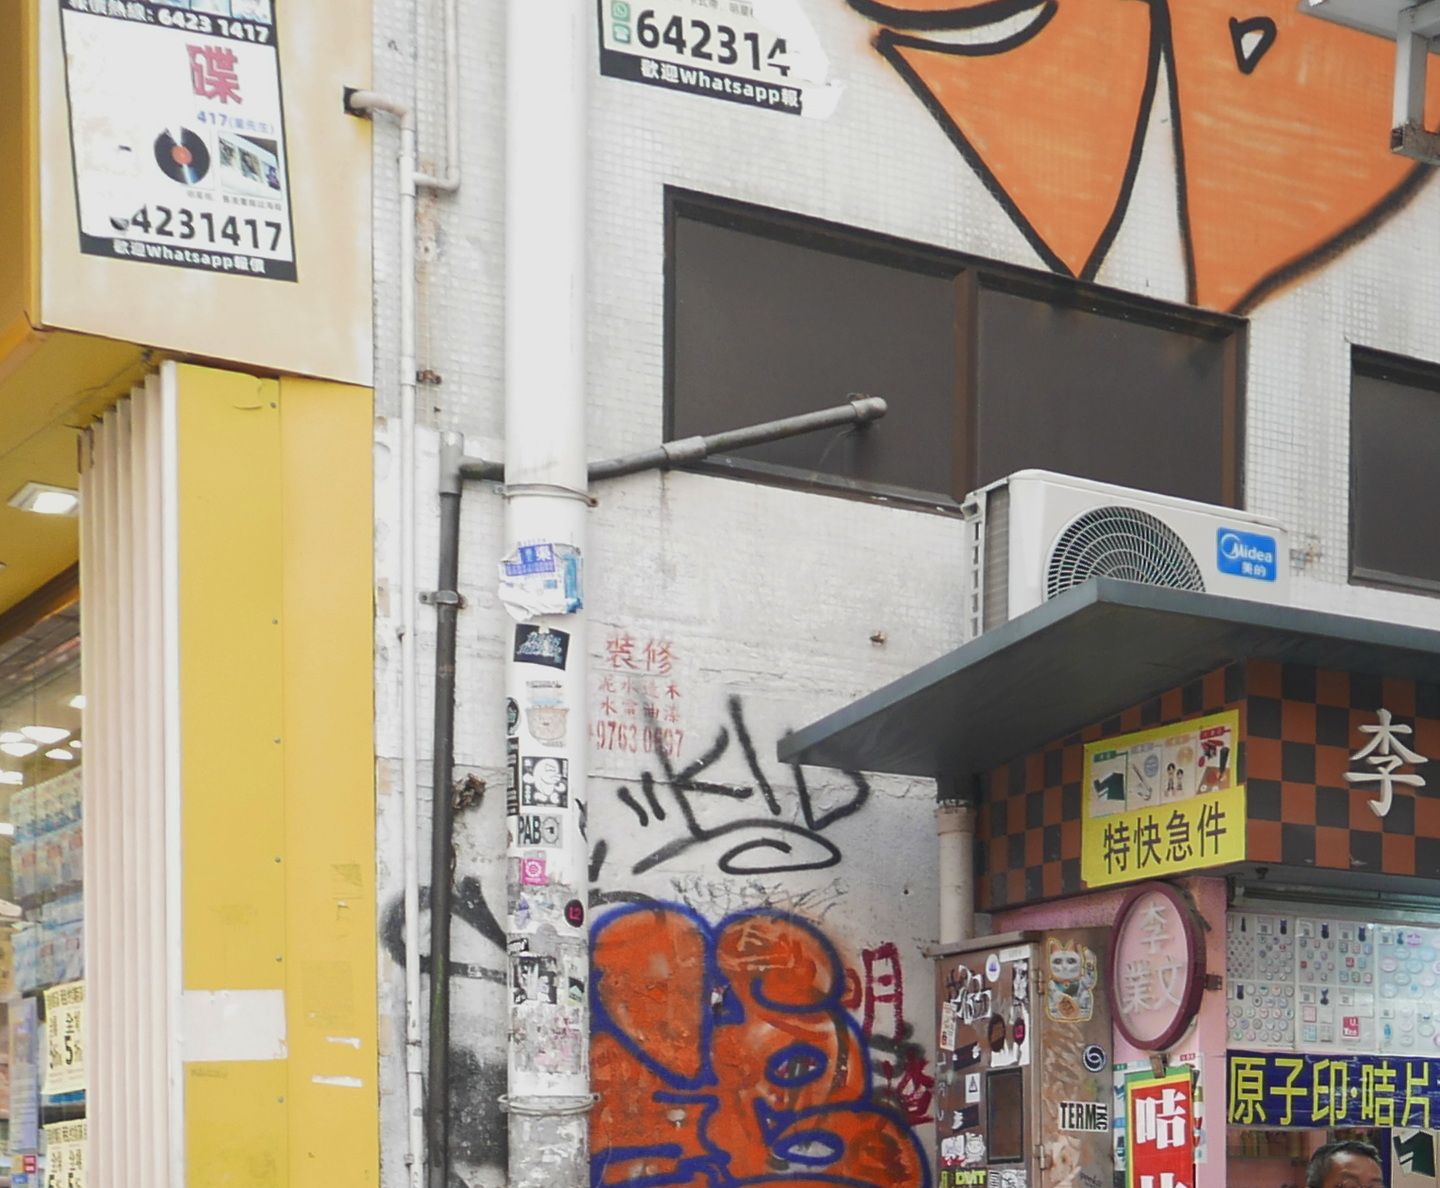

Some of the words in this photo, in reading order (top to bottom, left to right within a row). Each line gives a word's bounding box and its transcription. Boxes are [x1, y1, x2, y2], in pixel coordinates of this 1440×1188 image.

[158, 8, 212, 33] 6423
[217, 19, 270, 43] 1417
[606, 633, 680, 675] 裝修
[1103, 801, 1228, 875] 特快急件
[1060, 1102, 1097, 1130] TERM
